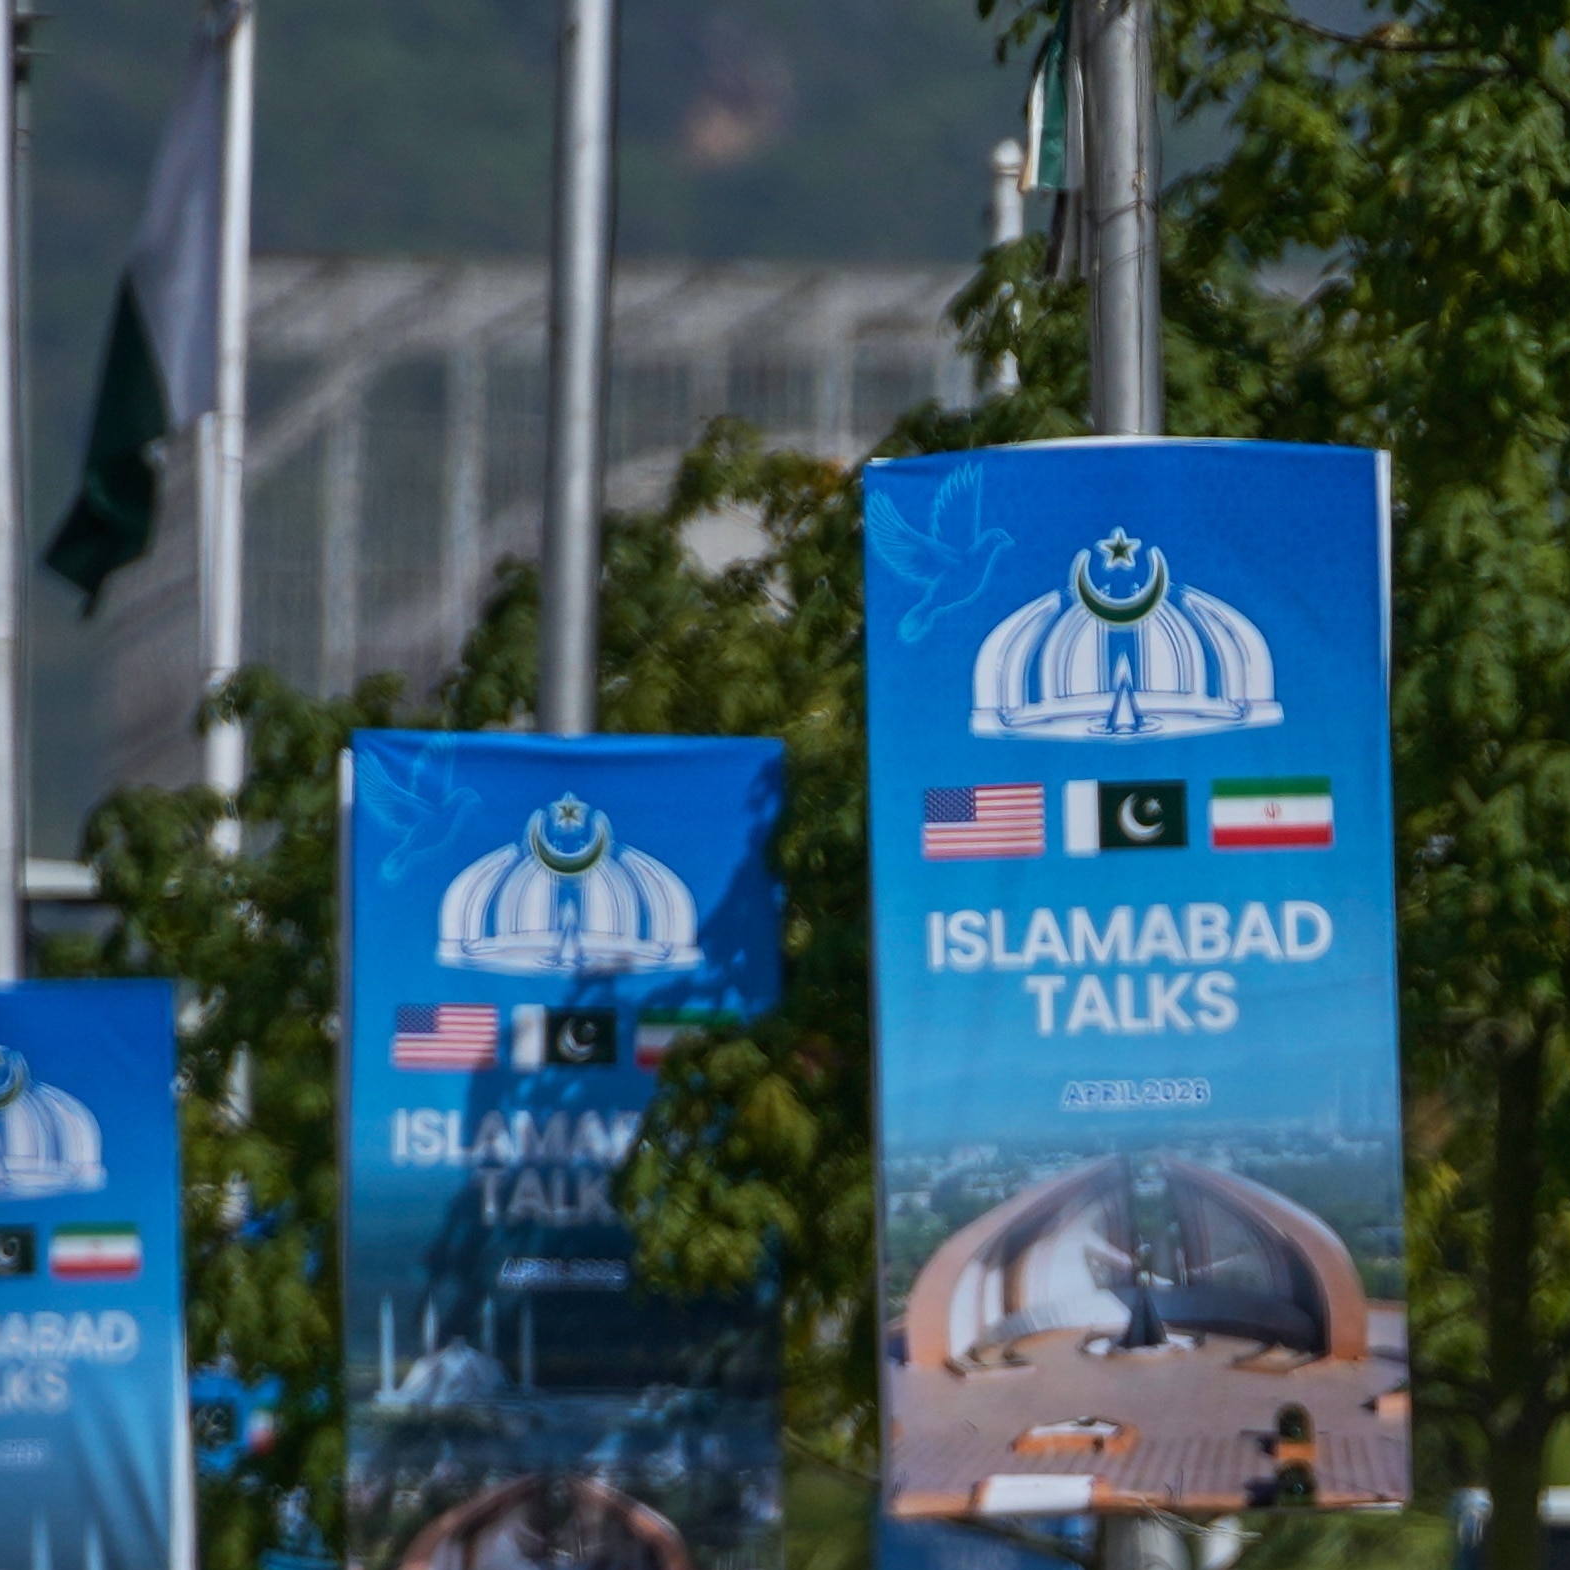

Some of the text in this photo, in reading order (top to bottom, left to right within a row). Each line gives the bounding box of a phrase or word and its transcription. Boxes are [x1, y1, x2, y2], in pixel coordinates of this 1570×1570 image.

[929, 900, 1333, 970] ISLAMABAD
[1027, 971, 1237, 1034] TALKS
[393, 1105, 641, 1166] ISLAMA
[479, 1168, 617, 1226] TALK
